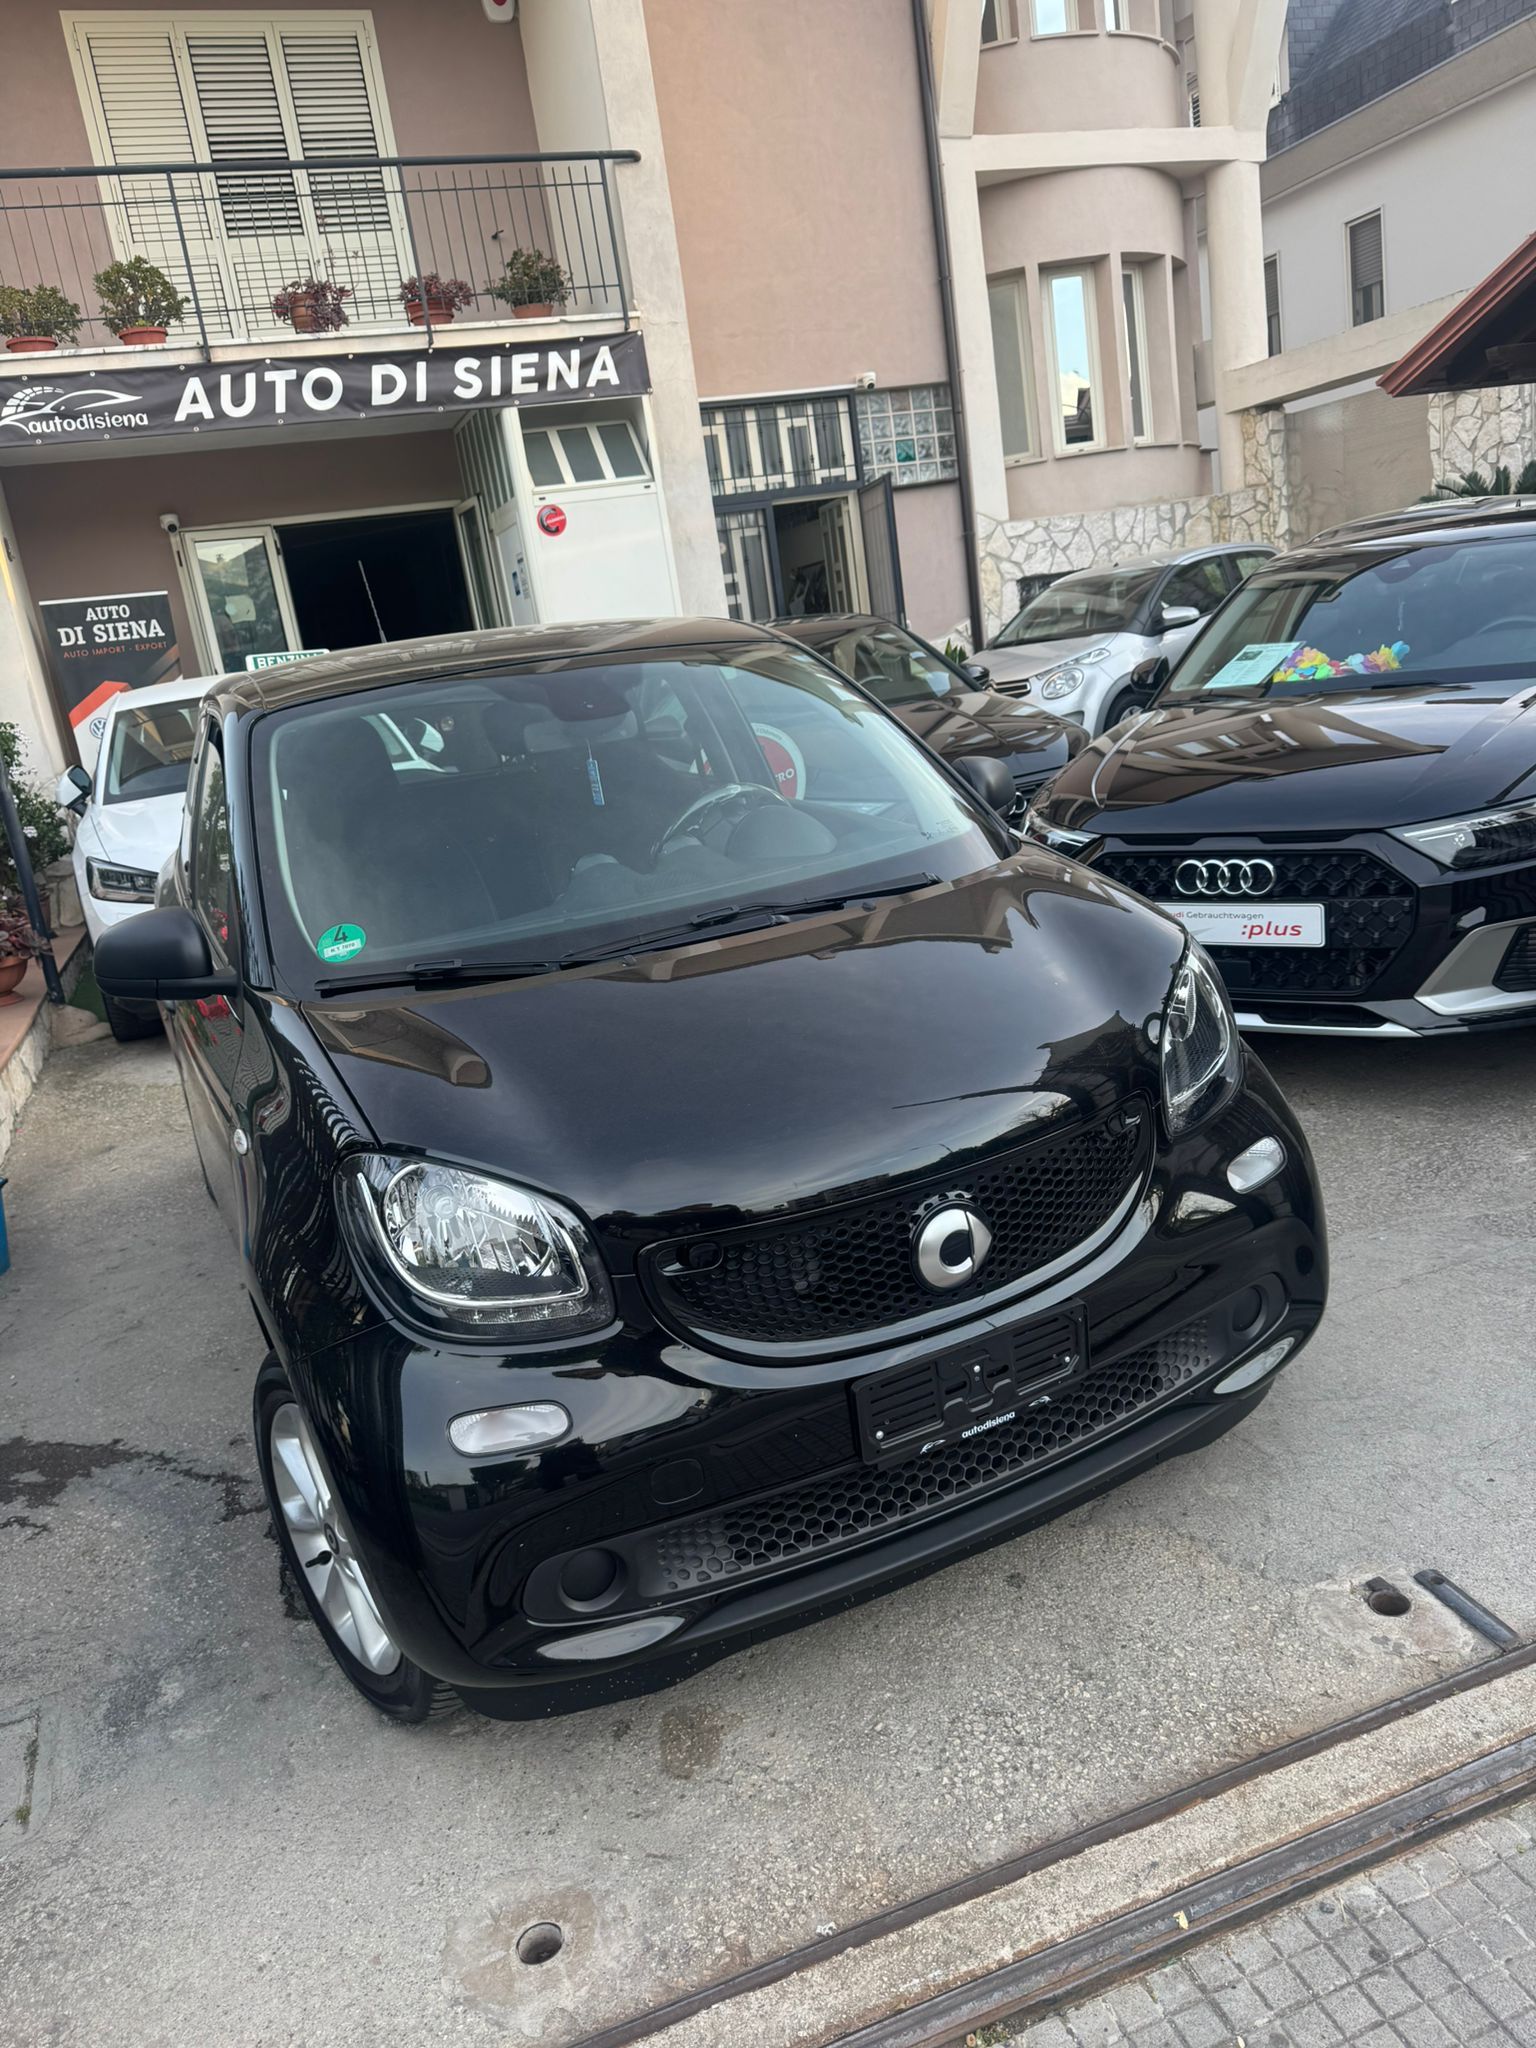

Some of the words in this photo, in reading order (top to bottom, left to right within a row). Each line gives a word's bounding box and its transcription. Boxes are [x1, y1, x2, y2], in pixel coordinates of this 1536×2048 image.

[174, 367, 343, 422] AUTO
[371, 361, 427, 406] DI
[453, 345, 620, 400] SIENA
[28, 411, 148, 434] autodisiena
[85, 604, 130, 622] AUTO
[57, 626, 86, 647] DI
[92, 618, 166, 643] SIENA
[63, 649, 89, 659] AUTO
[92, 645, 126, 656] IMPORT
[135, 641, 167, 651] EXPORT
[1186, 911, 1264, 921] Gebrauchtwagen
[333, 925, 348, 942] 4
[1241, 921, 1303, 940] :plus
[961, 1410, 1016, 1439] autodisiena
